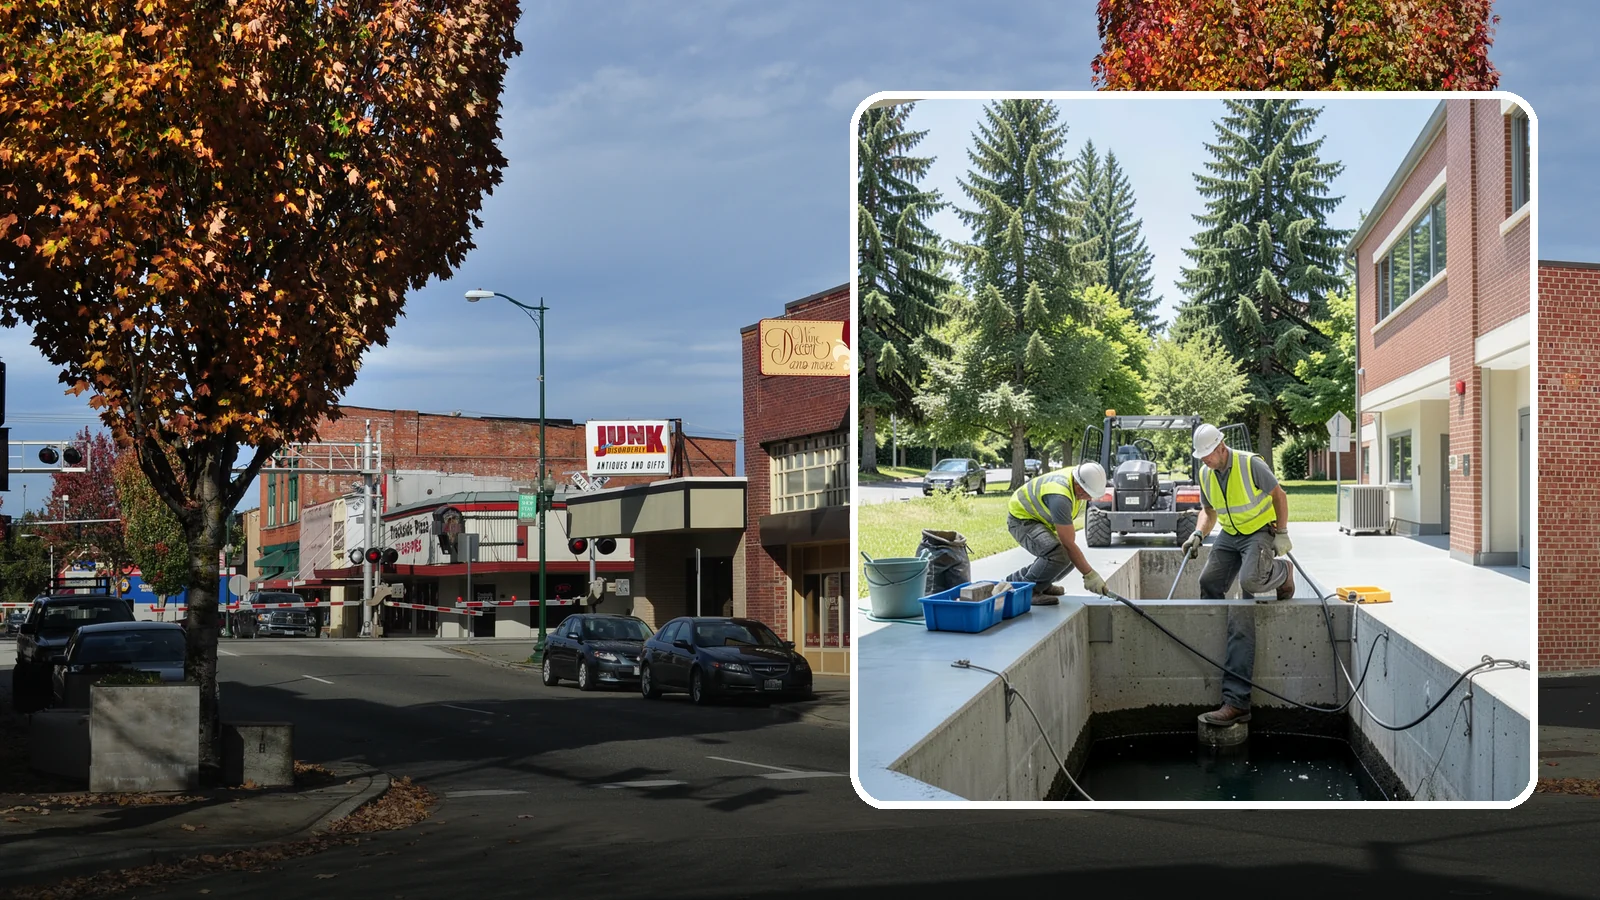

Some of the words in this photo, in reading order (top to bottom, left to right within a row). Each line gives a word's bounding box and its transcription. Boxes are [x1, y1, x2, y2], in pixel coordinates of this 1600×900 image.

[595, 425, 665, 457] JUNK
[607, 446, 646, 454] DISORDERLY
[597, 461, 628, 470] ANTIQUES
[631, 461, 643, 470] AND
[647, 460, 665, 469] GIFTS
[414, 519, 429, 534] Pizza
